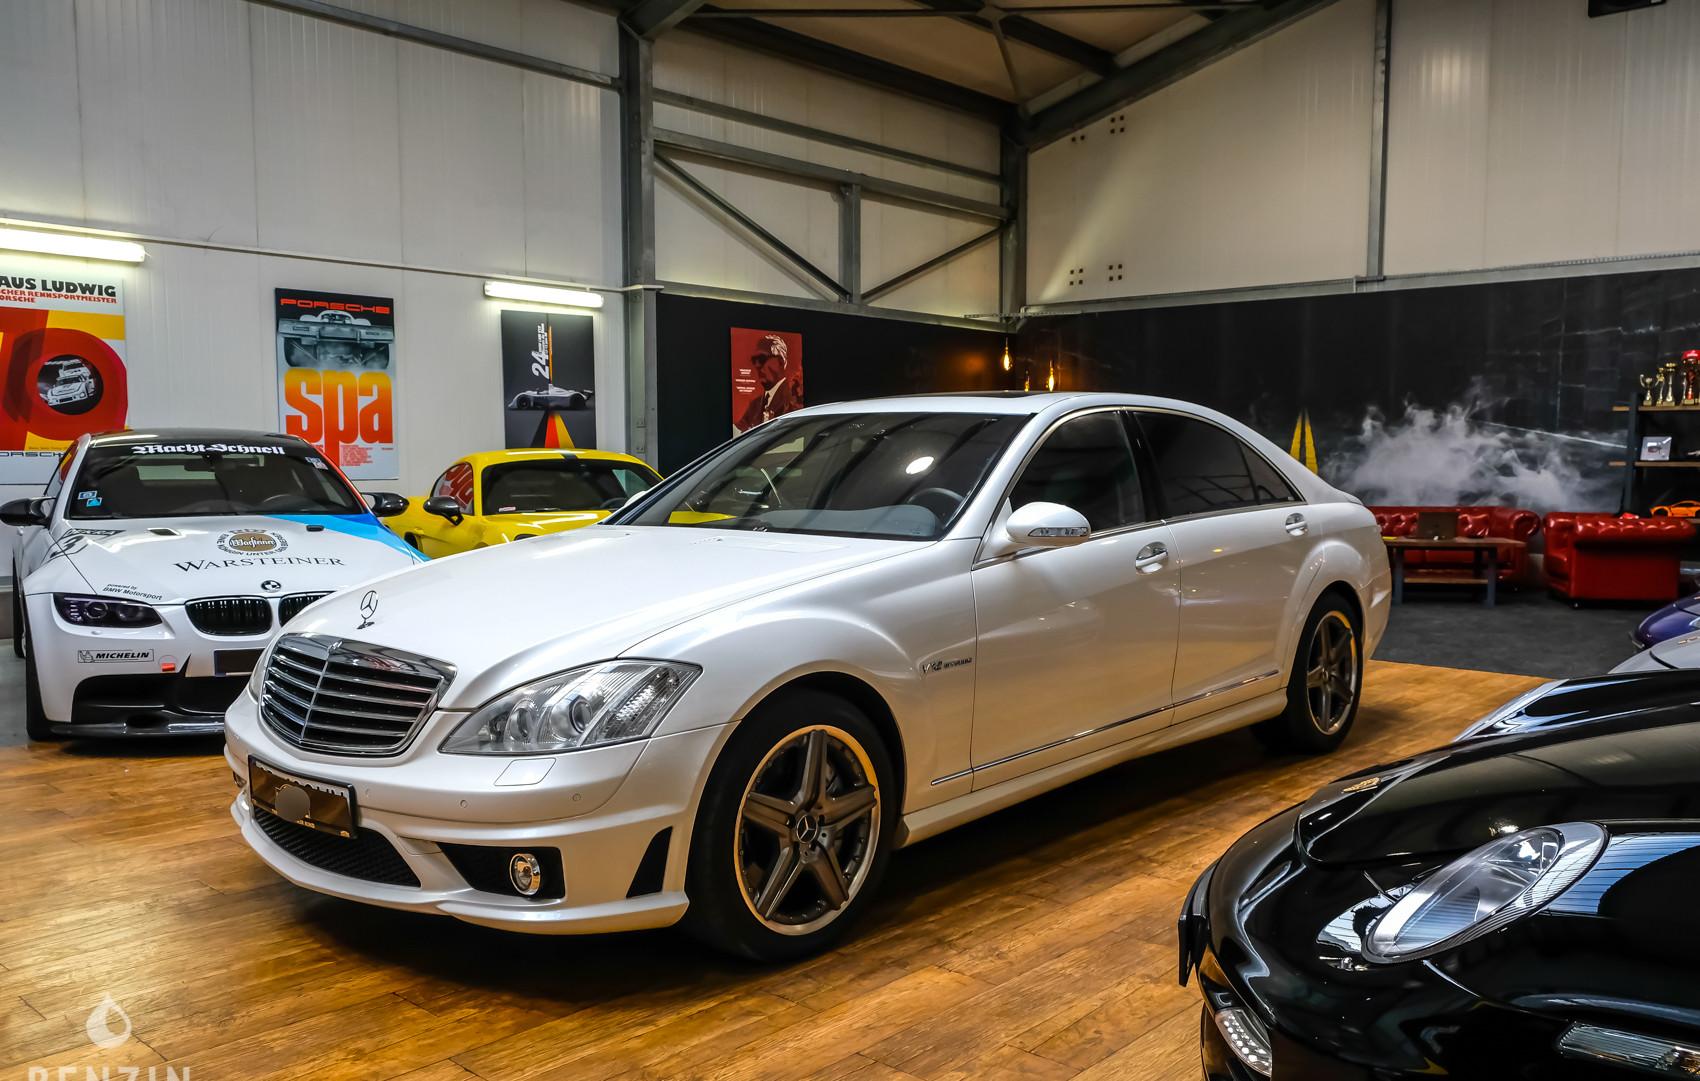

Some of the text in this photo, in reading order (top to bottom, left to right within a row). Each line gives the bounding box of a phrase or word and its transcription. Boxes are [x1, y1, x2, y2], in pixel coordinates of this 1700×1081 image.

[0, 276, 116, 297] AUS LUDWIG
[28, 290, 117, 304] RENNSPORTMEISTER
[280, 298, 390, 314] PORSCHE
[531, 350, 549, 380] 24
[284, 368, 394, 468] spa
[175, 557, 346, 572] WARSTEINER
[123, 589, 162, 601] Motorsport
